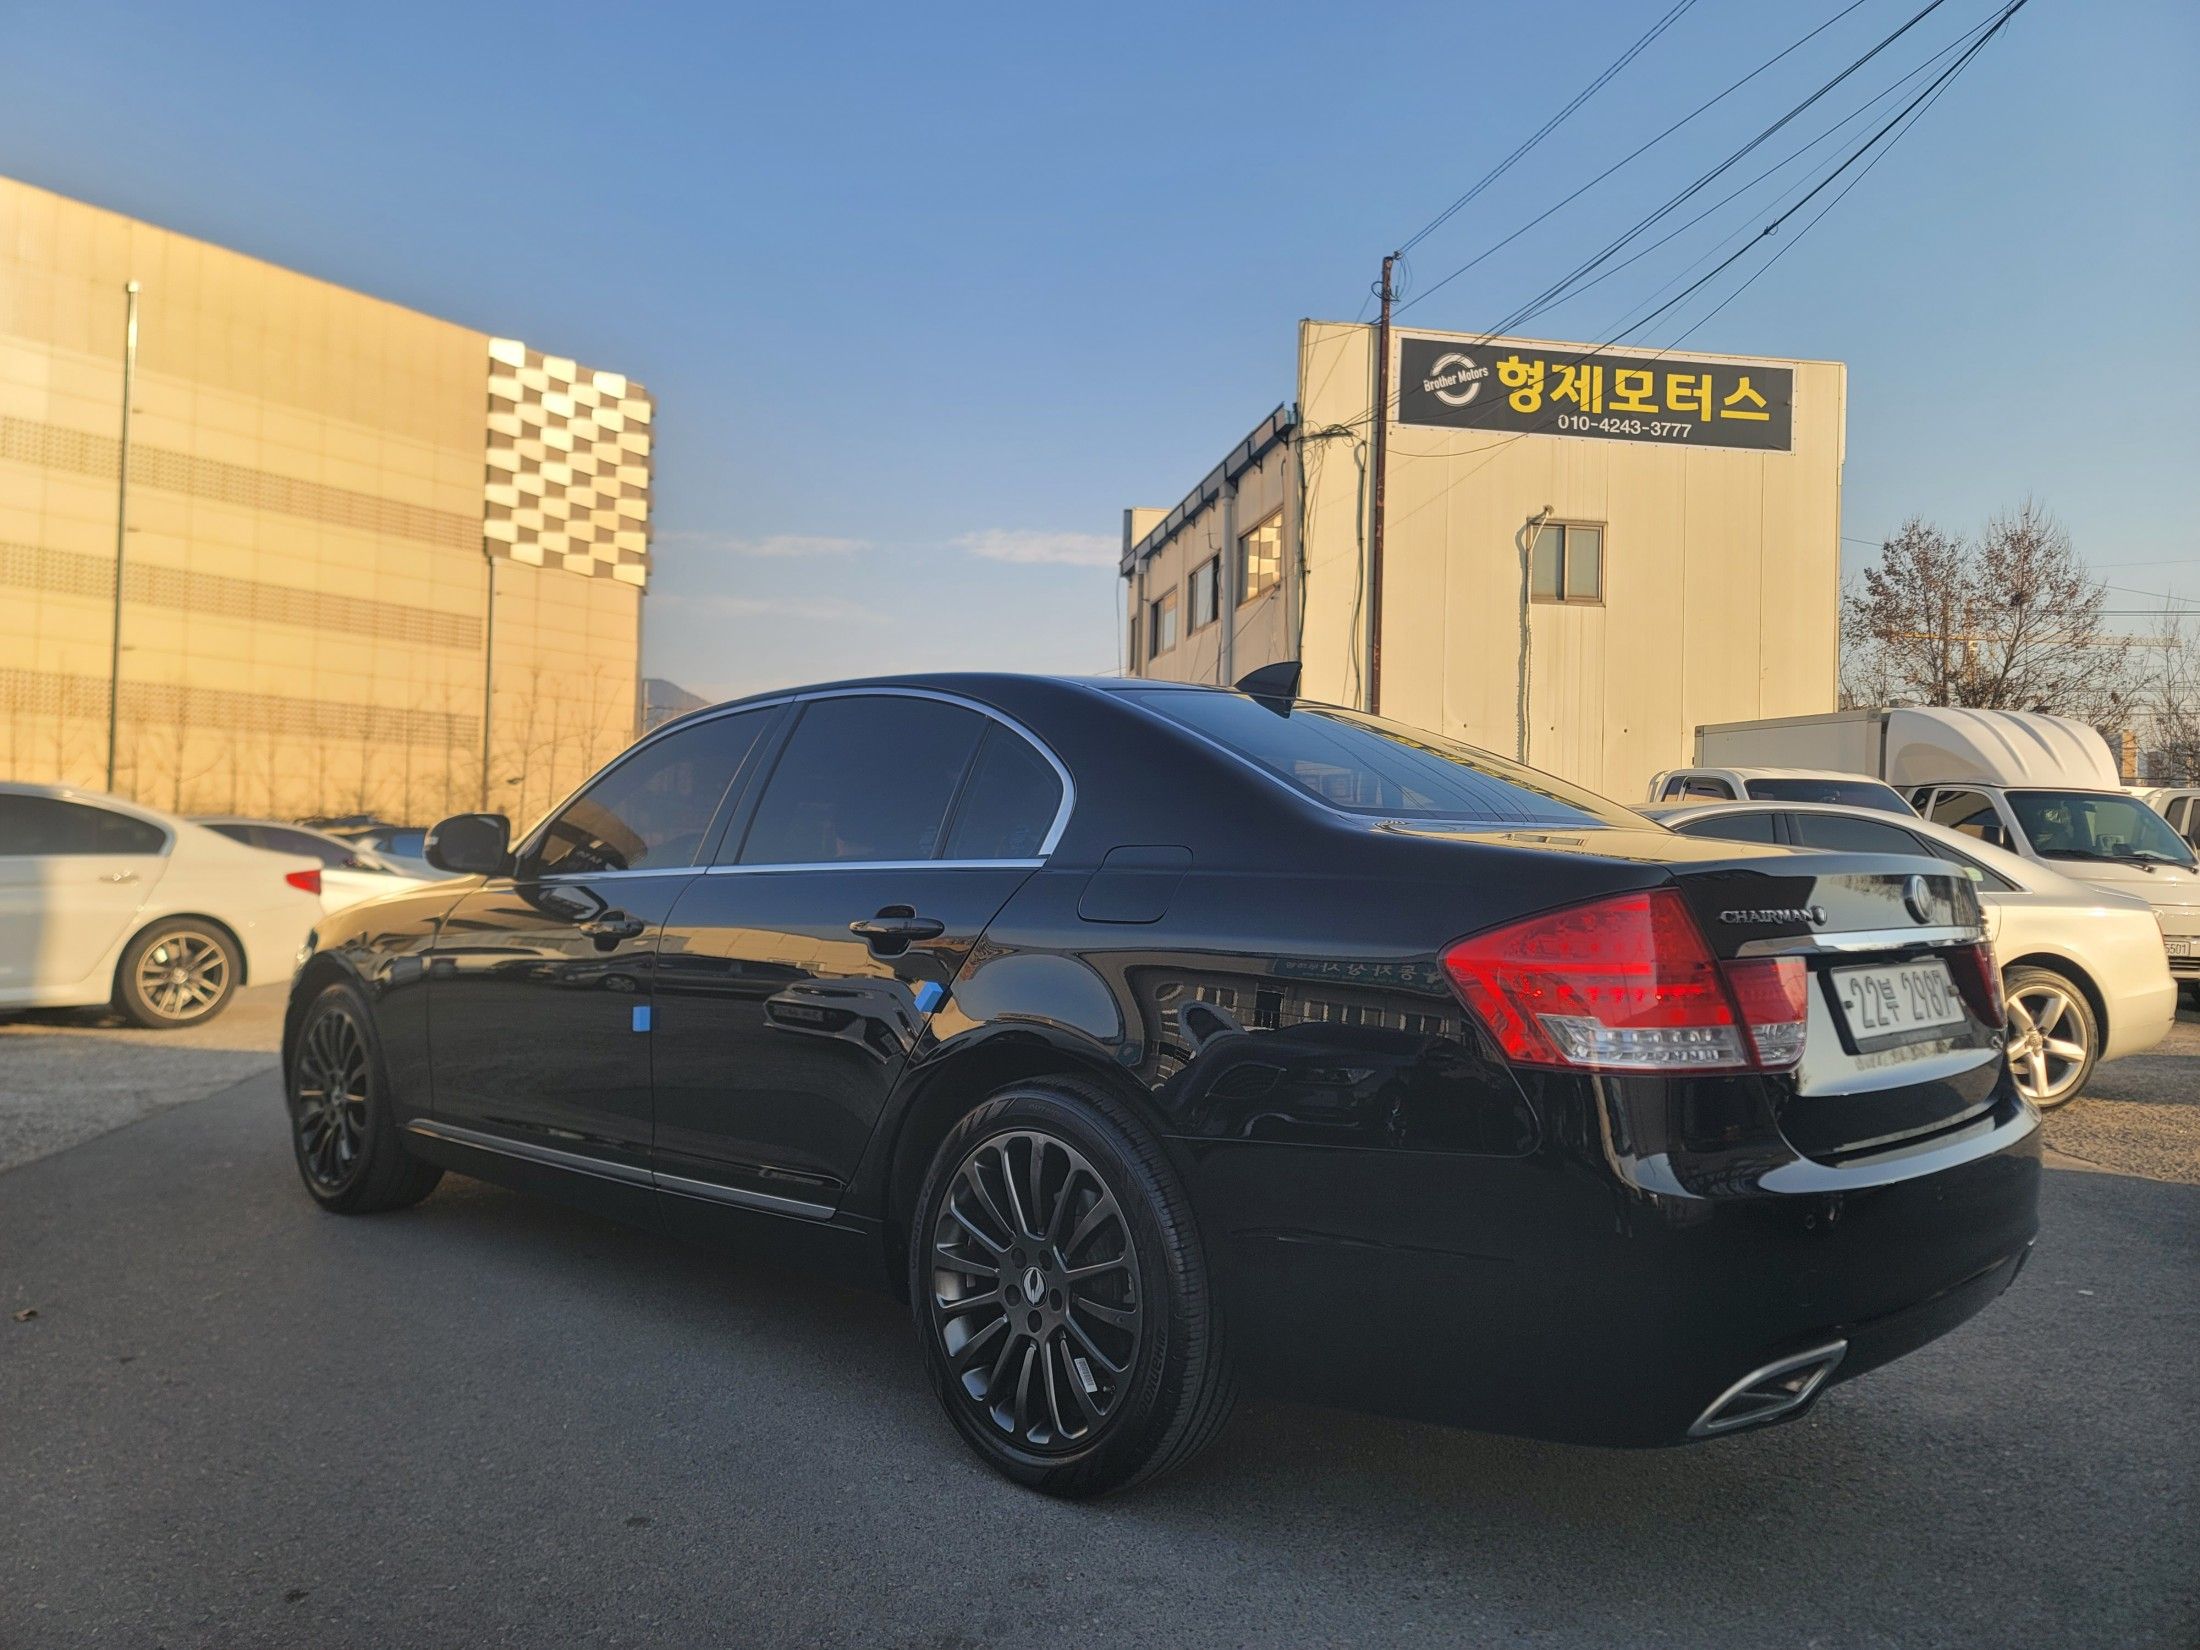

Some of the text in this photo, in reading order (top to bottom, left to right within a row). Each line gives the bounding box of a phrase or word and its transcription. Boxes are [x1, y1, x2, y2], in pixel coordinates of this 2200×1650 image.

[1423, 367, 1489, 392] Brother Motors
[1496, 355, 1770, 422] 형제모터스
[1557, 414, 1692, 438] 010-4243-3777
[1719, 909, 1813, 924] CHAIRMAN
